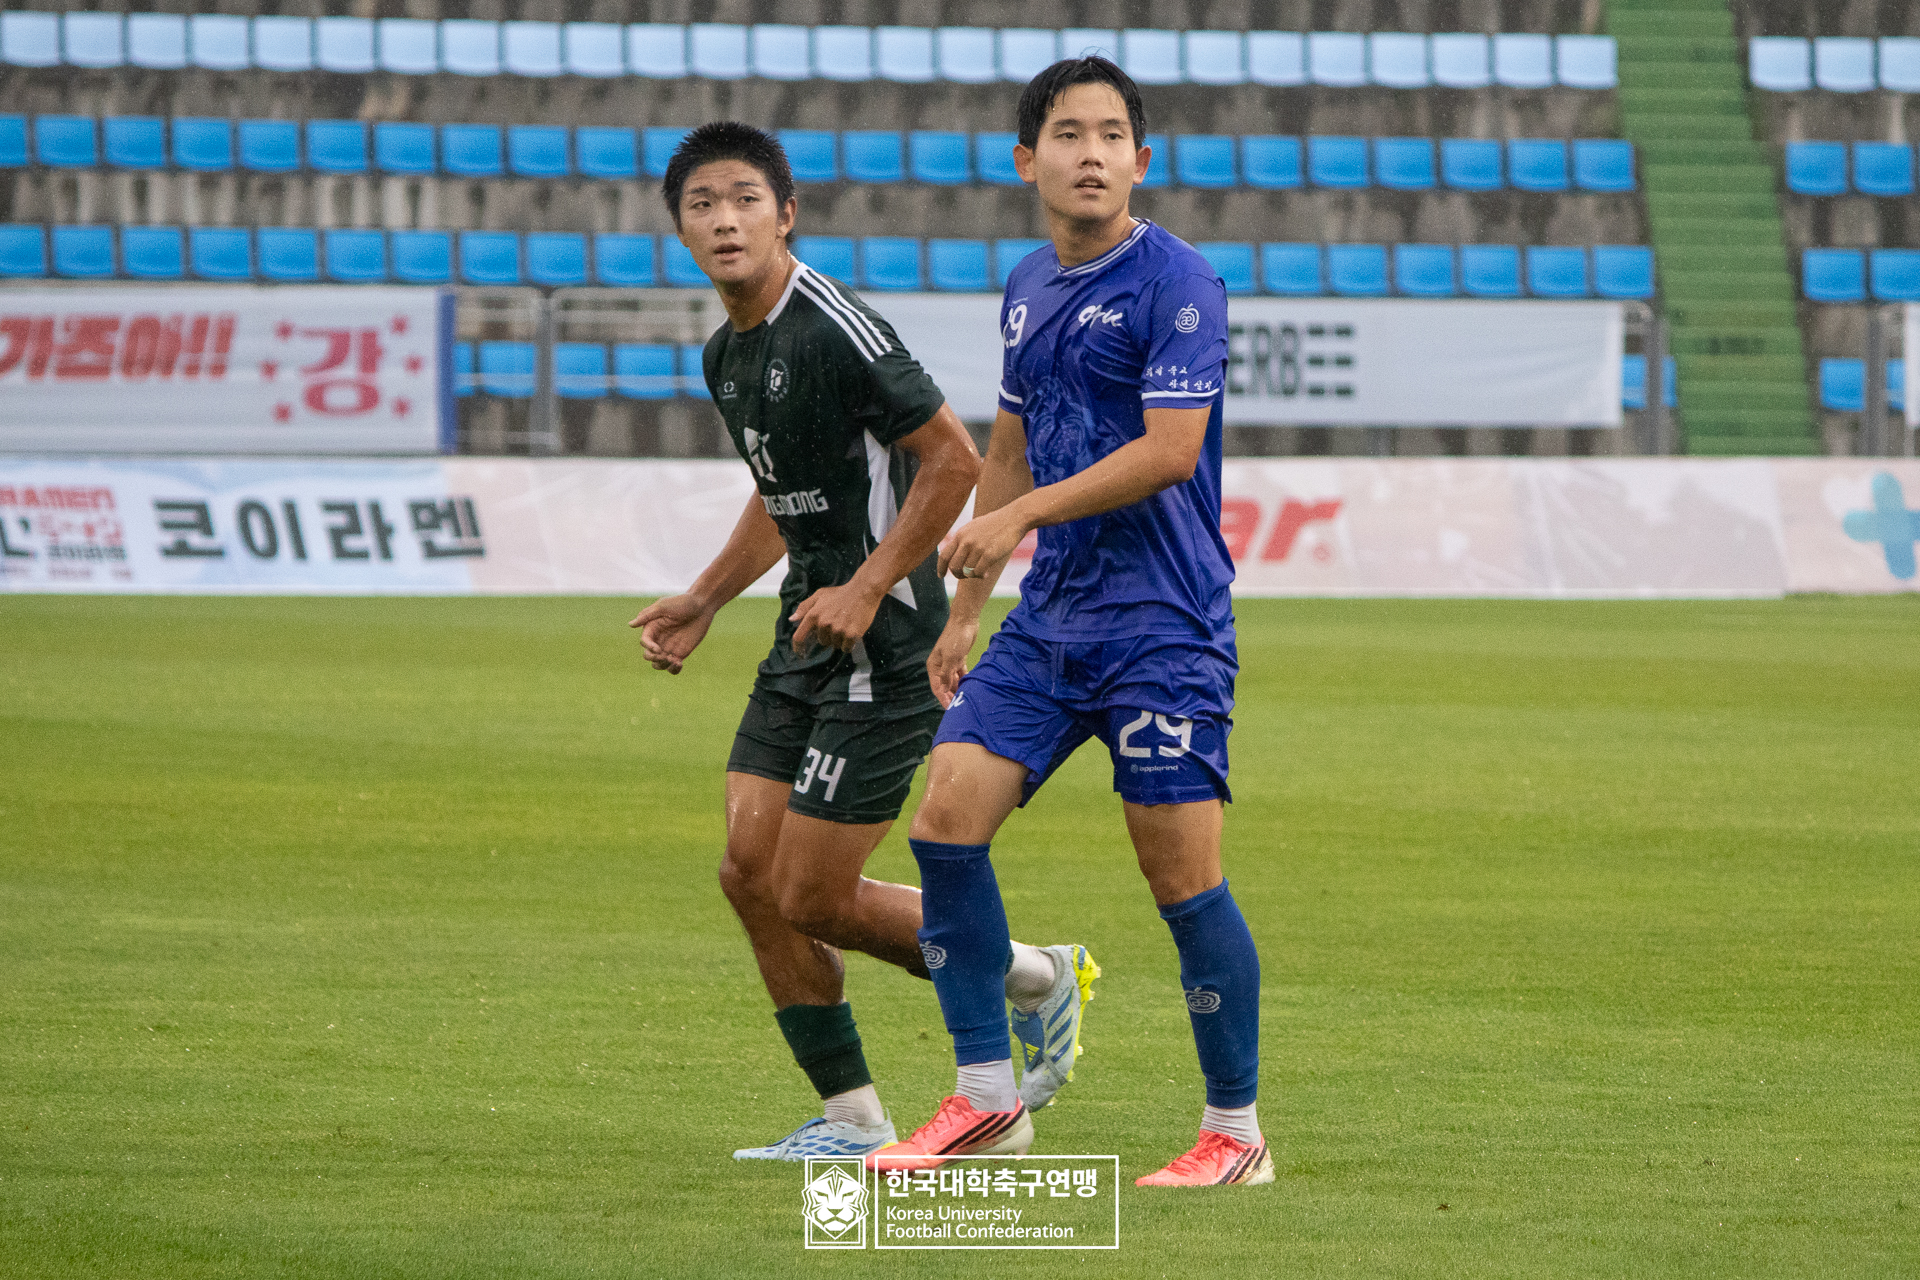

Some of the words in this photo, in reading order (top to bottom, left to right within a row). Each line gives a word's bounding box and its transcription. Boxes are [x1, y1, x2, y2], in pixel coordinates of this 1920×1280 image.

[300, 327, 385, 417] 강
[153, 497, 487, 561] 코이라멘
[1119, 709, 1193, 758] 29
[794, 747, 847, 802] 34
